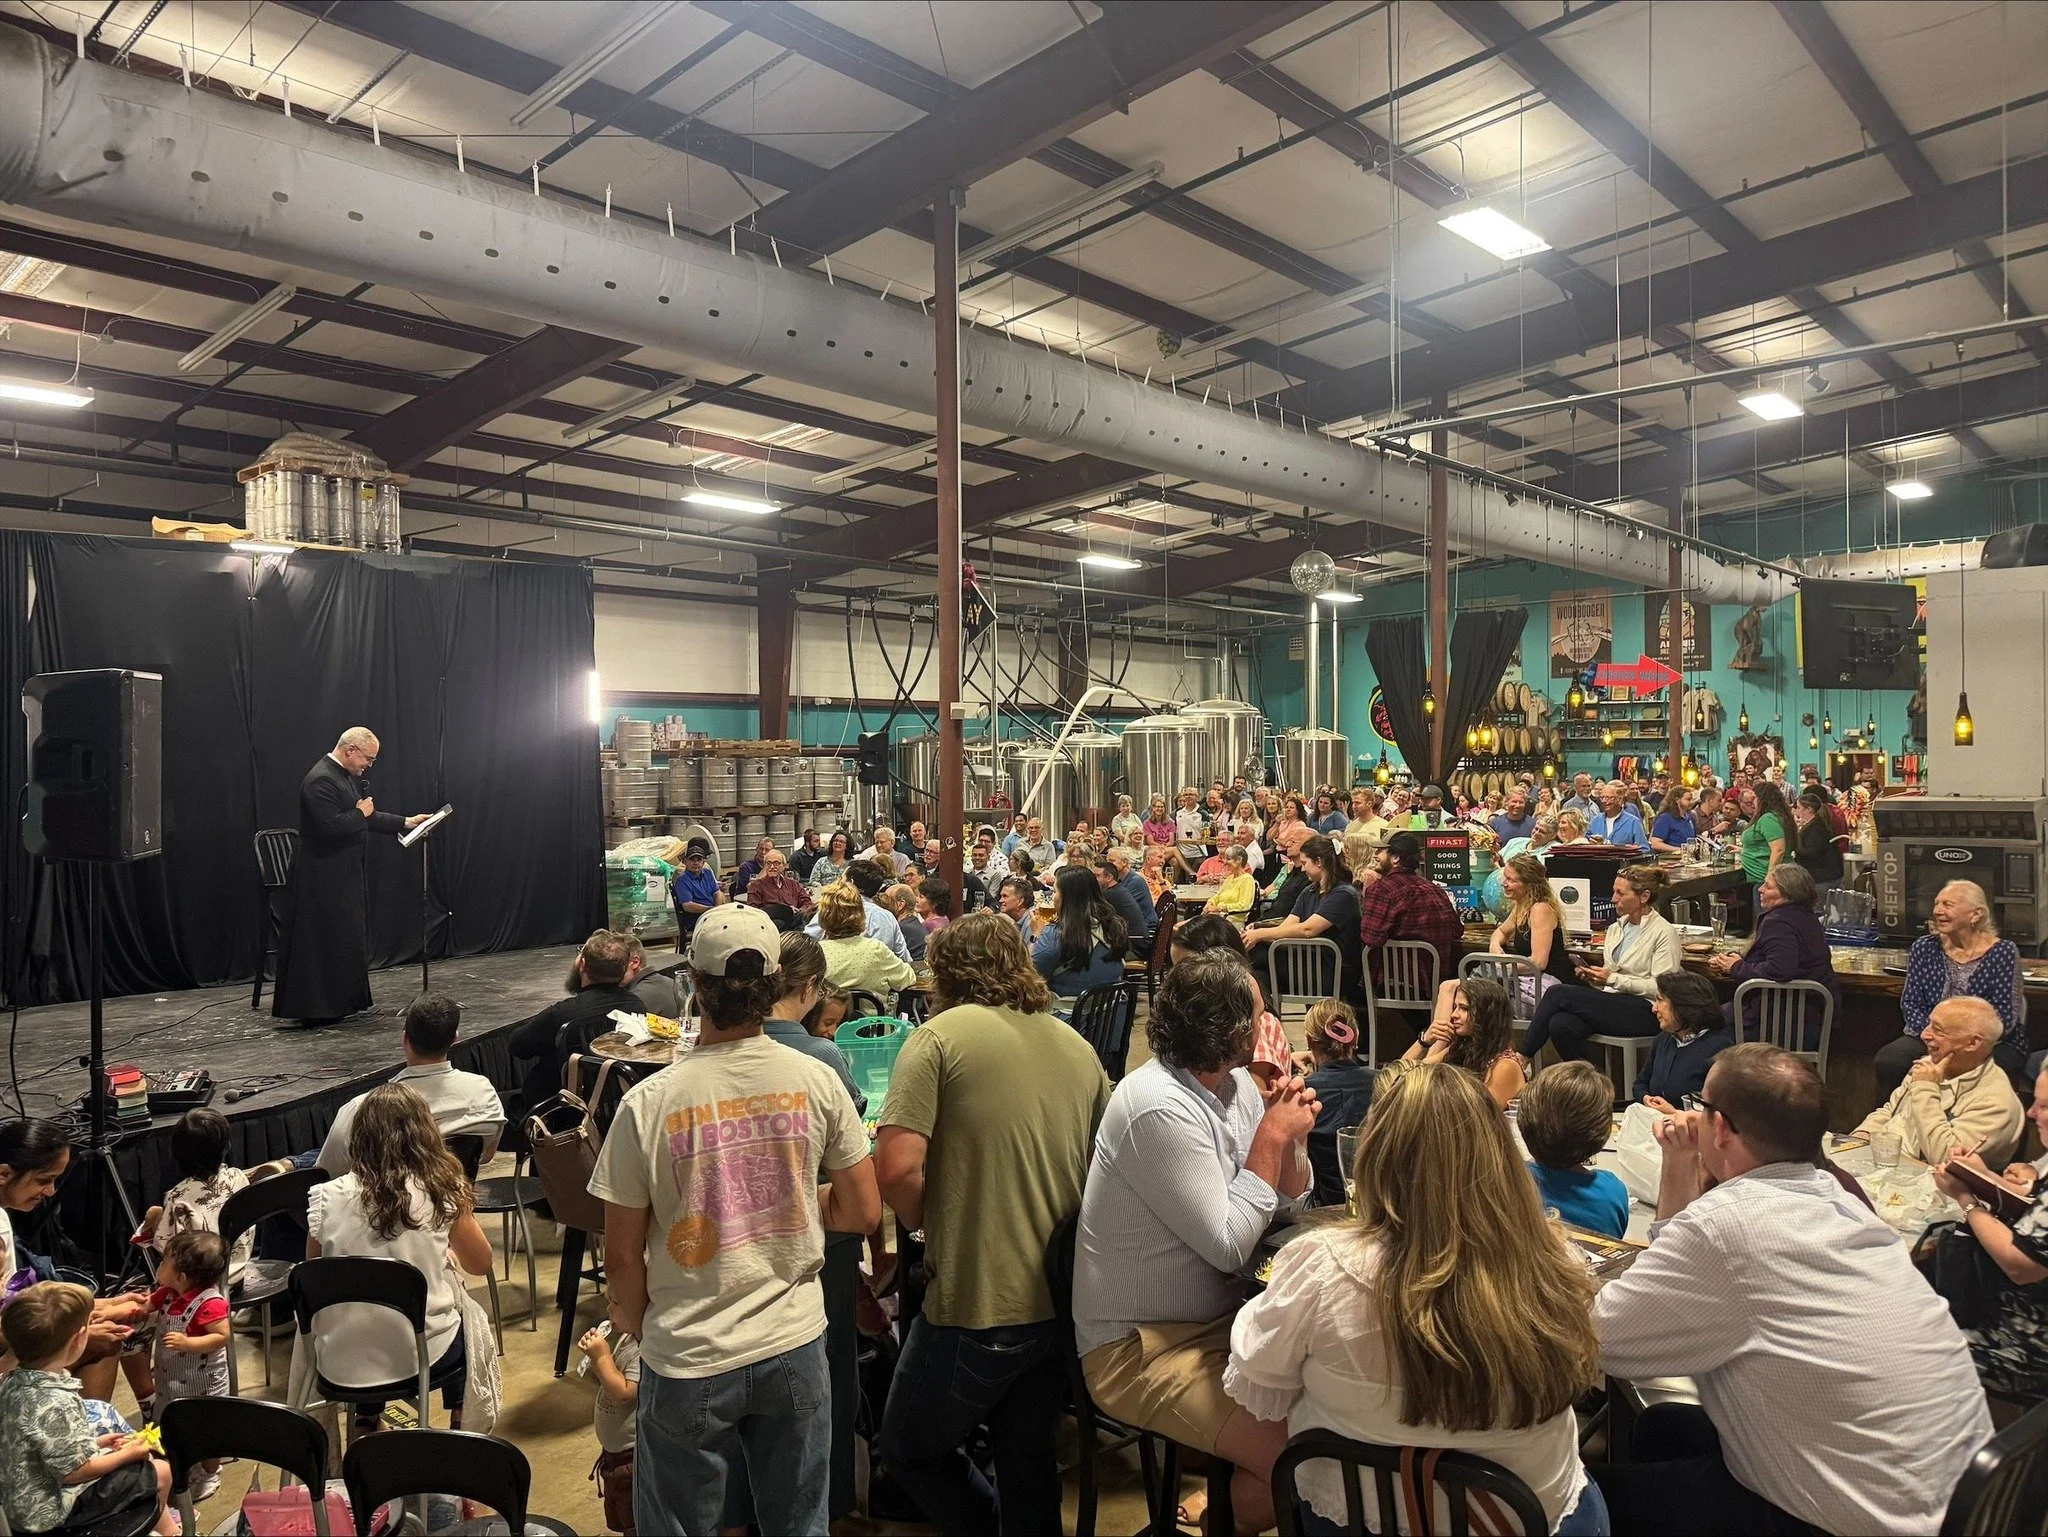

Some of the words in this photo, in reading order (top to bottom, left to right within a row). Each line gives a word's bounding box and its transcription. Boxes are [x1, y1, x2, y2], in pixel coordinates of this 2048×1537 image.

[1556, 603, 1605, 620] WOODBOOGER
[1884, 852, 1898, 927] CHEFTOP
[666, 1103, 713, 1135] BEN
[717, 1091, 809, 1120] RECTOR
[701, 1111, 809, 1149] BOSTON
